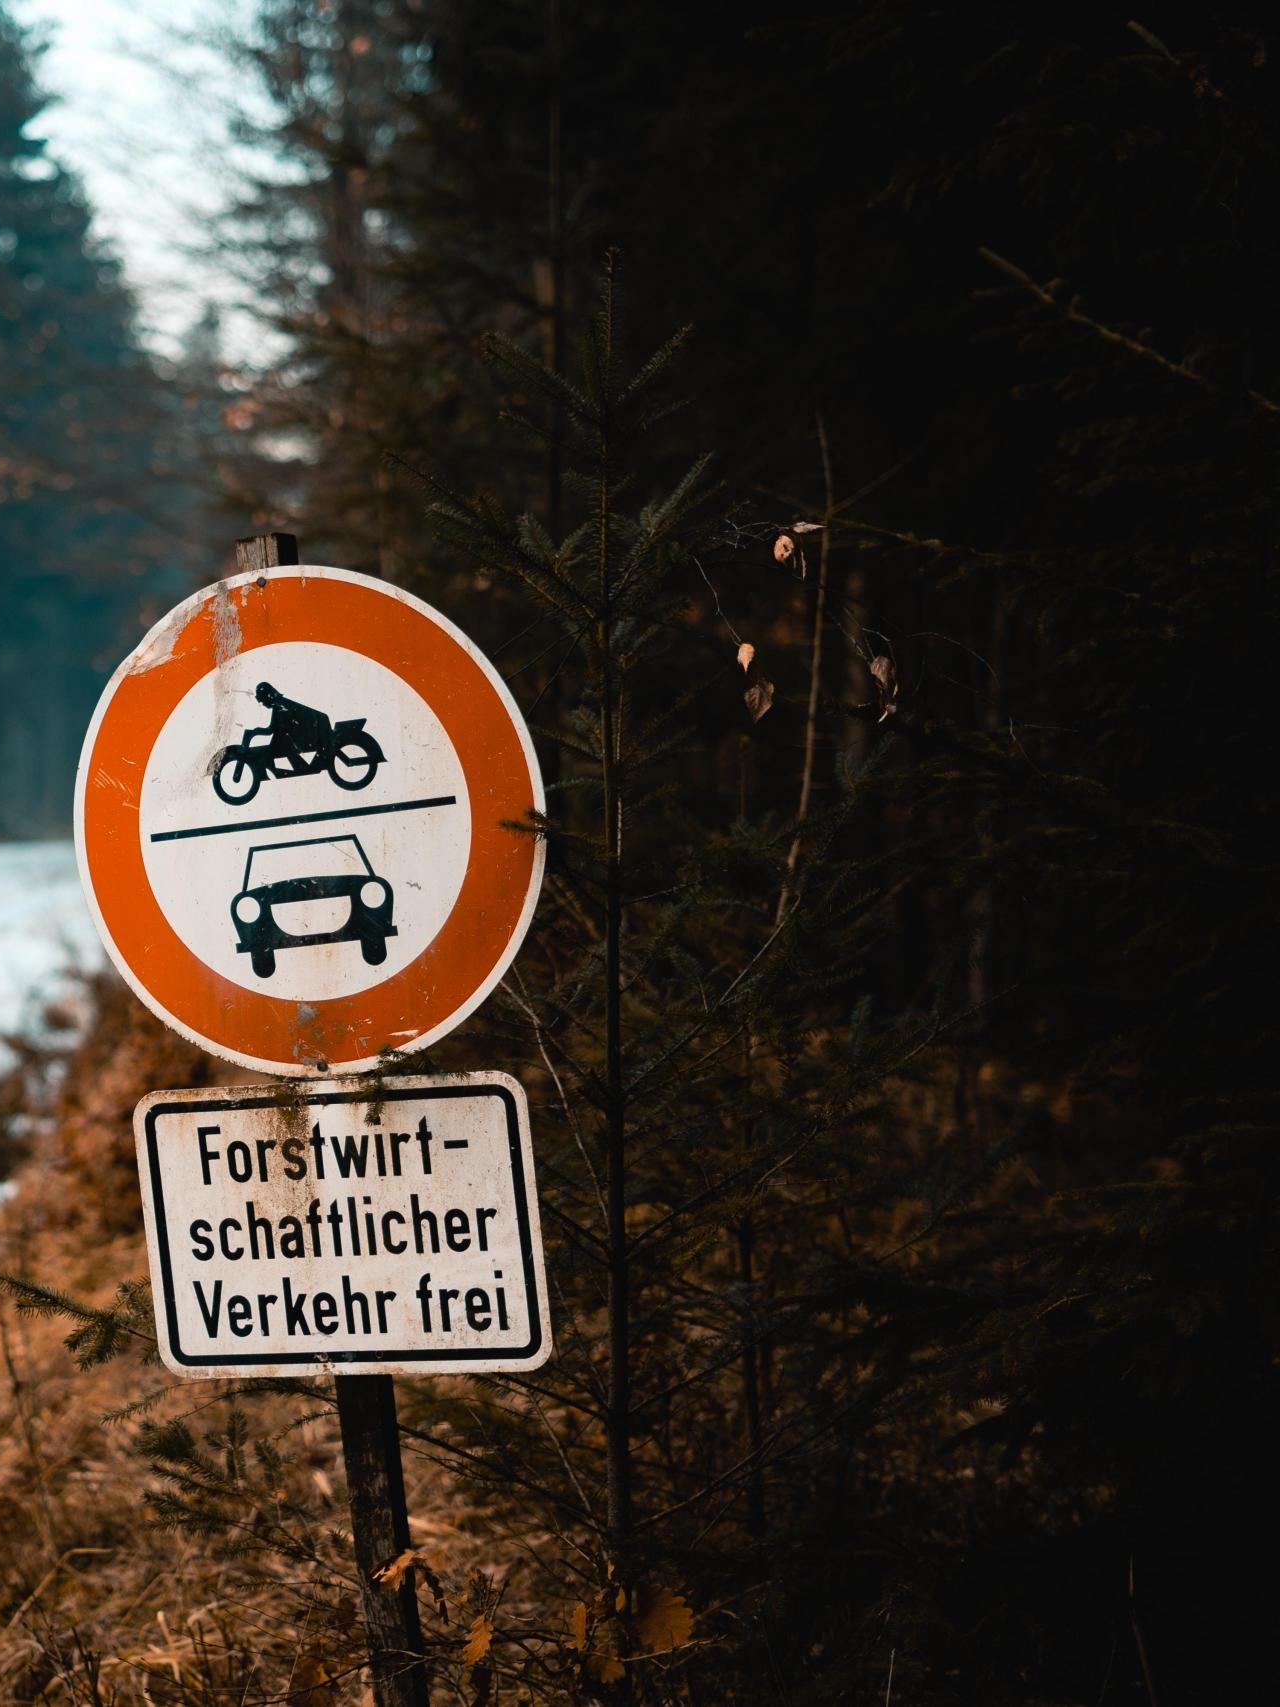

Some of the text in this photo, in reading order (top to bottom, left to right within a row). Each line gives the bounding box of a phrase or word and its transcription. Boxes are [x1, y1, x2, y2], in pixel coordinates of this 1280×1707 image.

[197, 1115, 469, 1185] Forstwirt-
[189, 1194, 498, 1261] schaftlicher
[192, 1270, 510, 1339] Verkehr frei
